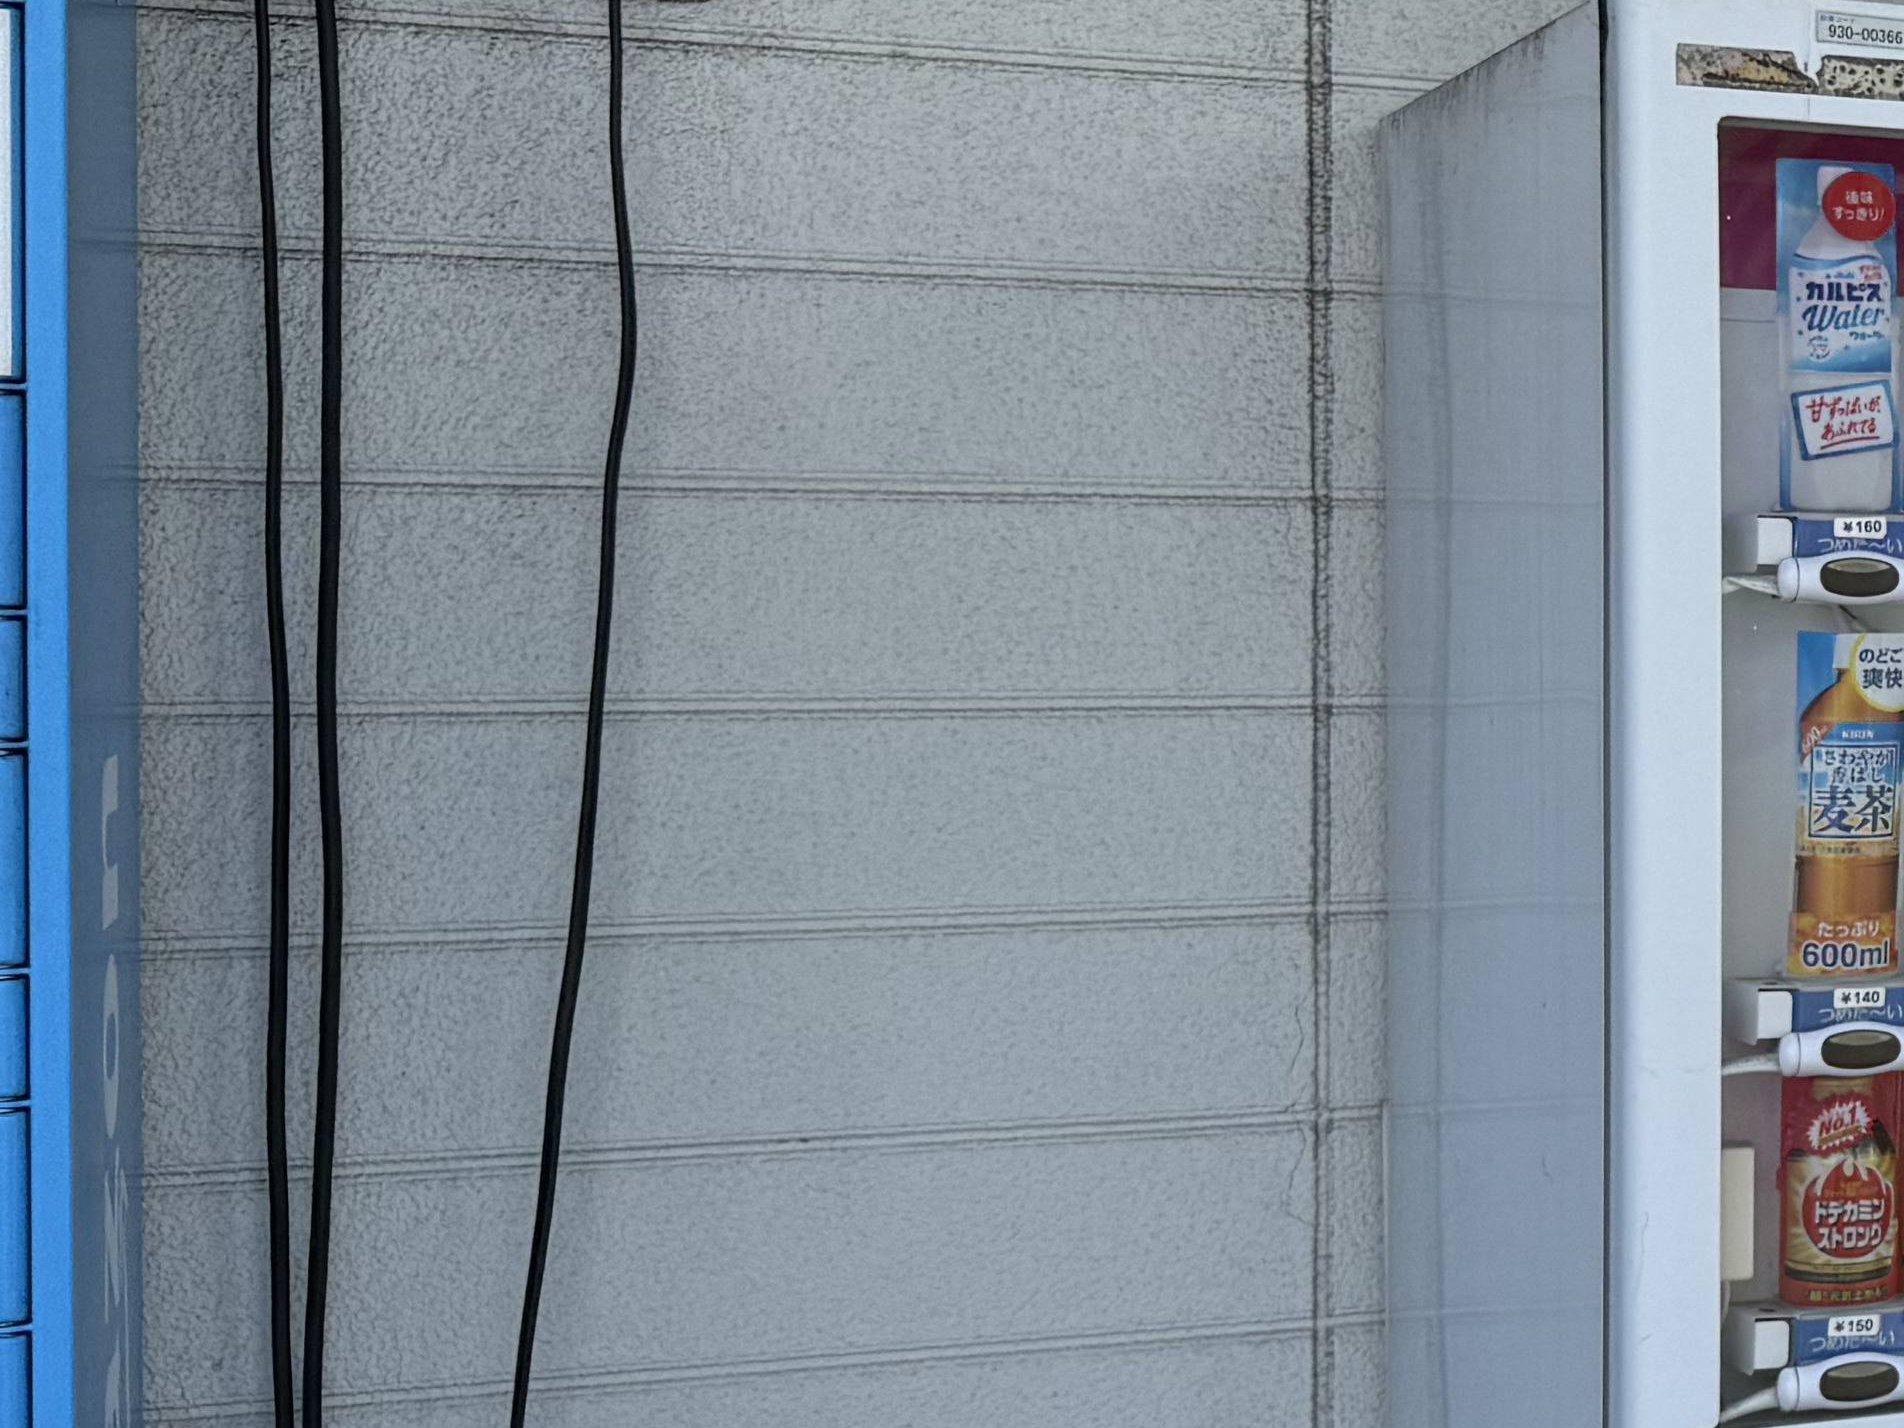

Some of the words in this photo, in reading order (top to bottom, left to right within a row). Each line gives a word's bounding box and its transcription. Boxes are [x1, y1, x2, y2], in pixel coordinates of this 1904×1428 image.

[1805, 281, 1883, 303] カルピス
[1801, 303, 1886, 333] Water
[1812, 785, 1893, 834] 麦茶
[1817, 919, 1881, 939] たっぷり
[1802, 939, 1890, 969] 600ml
[1840, 990, 1881, 1005] ¥140
[1814, 1197, 1886, 1225] ドデカミン
[1817, 1225, 1883, 1253] ストロング
